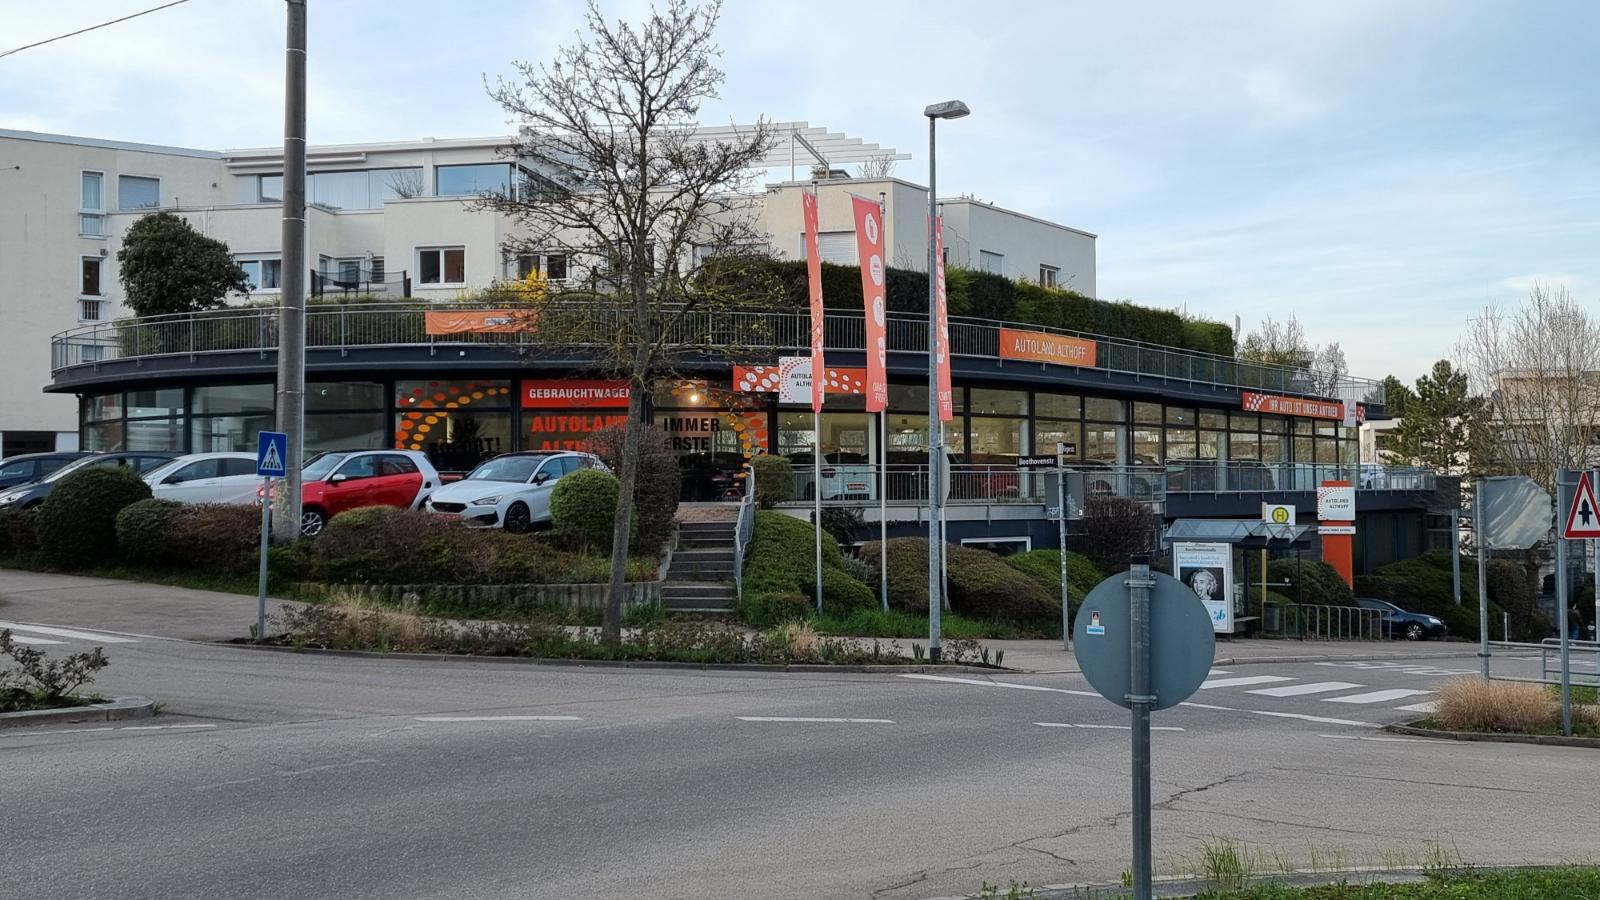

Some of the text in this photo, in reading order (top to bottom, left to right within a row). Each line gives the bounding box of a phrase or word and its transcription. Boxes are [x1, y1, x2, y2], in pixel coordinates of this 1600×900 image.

[1014, 338, 1086, 359] AUTOLAND ALTHOFF
[529, 388, 630, 398] GEBRAUCHTWAGEN
[1280, 400, 1292, 413] AUTO
[1293, 402, 1301, 414] IST
[1302, 403, 1318, 415] UNSER
[663, 418, 720, 432] IMMER
[1276, 511, 1284, 520] H
